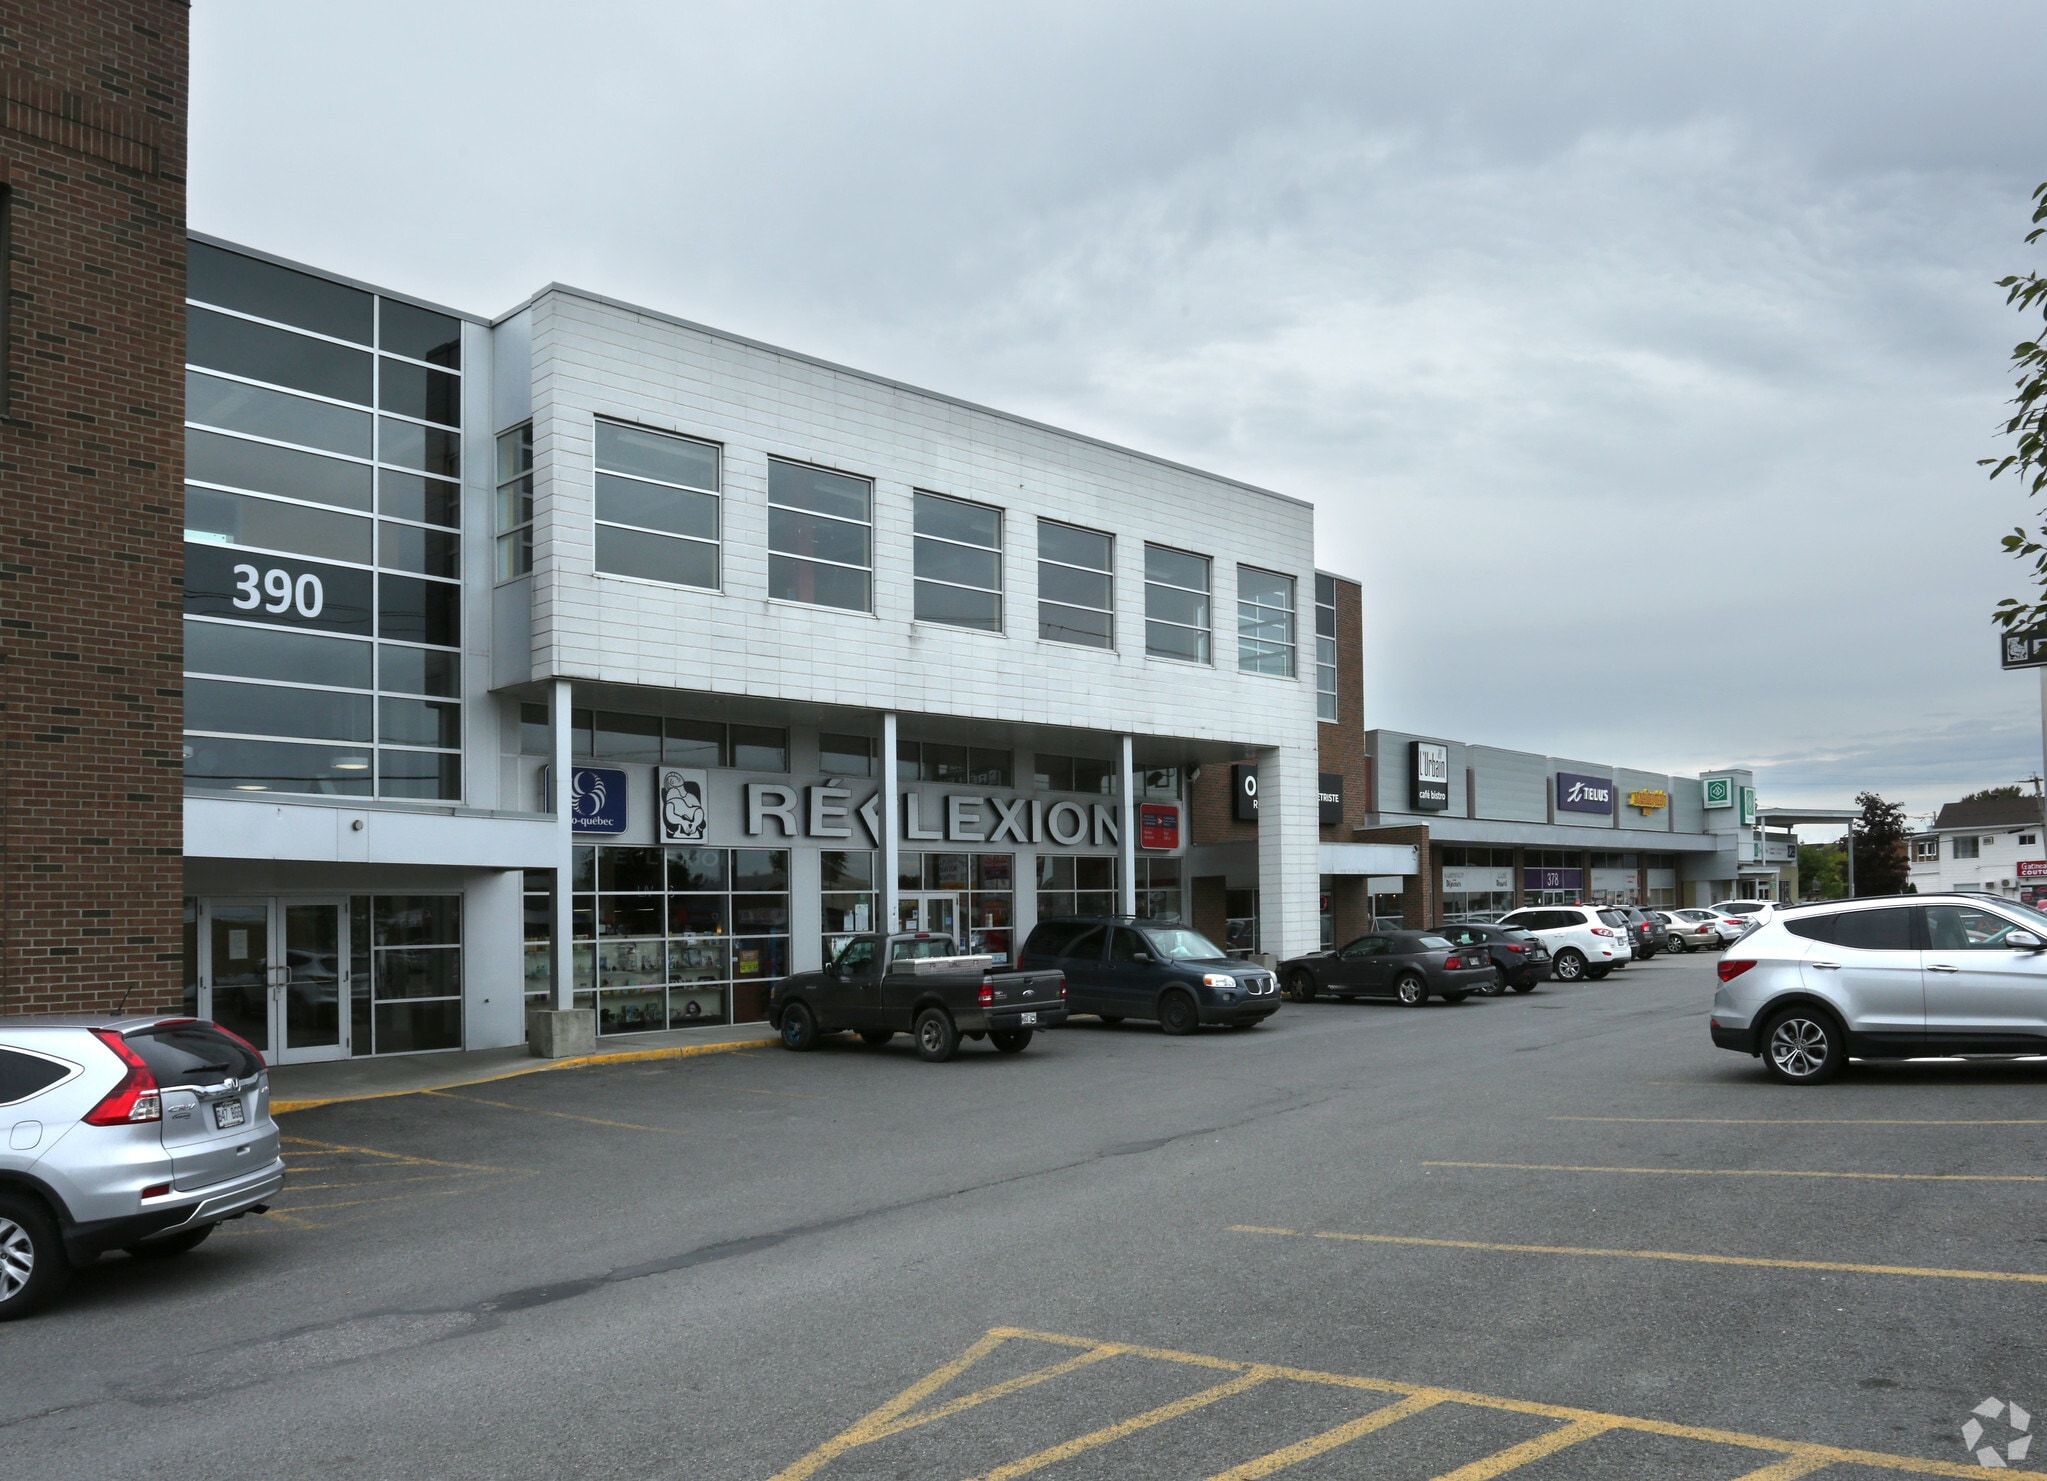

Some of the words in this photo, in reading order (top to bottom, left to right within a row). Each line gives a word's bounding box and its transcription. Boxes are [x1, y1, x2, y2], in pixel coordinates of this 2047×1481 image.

[231, 563, 325, 618] 390
[1419, 789, 1430, 800] café
[1431, 790, 1446, 801] bistro
[1583, 786, 1609, 803] TELUS
[572, 815, 615, 828] o-québec
[1546, 872, 1559, 886] 378
